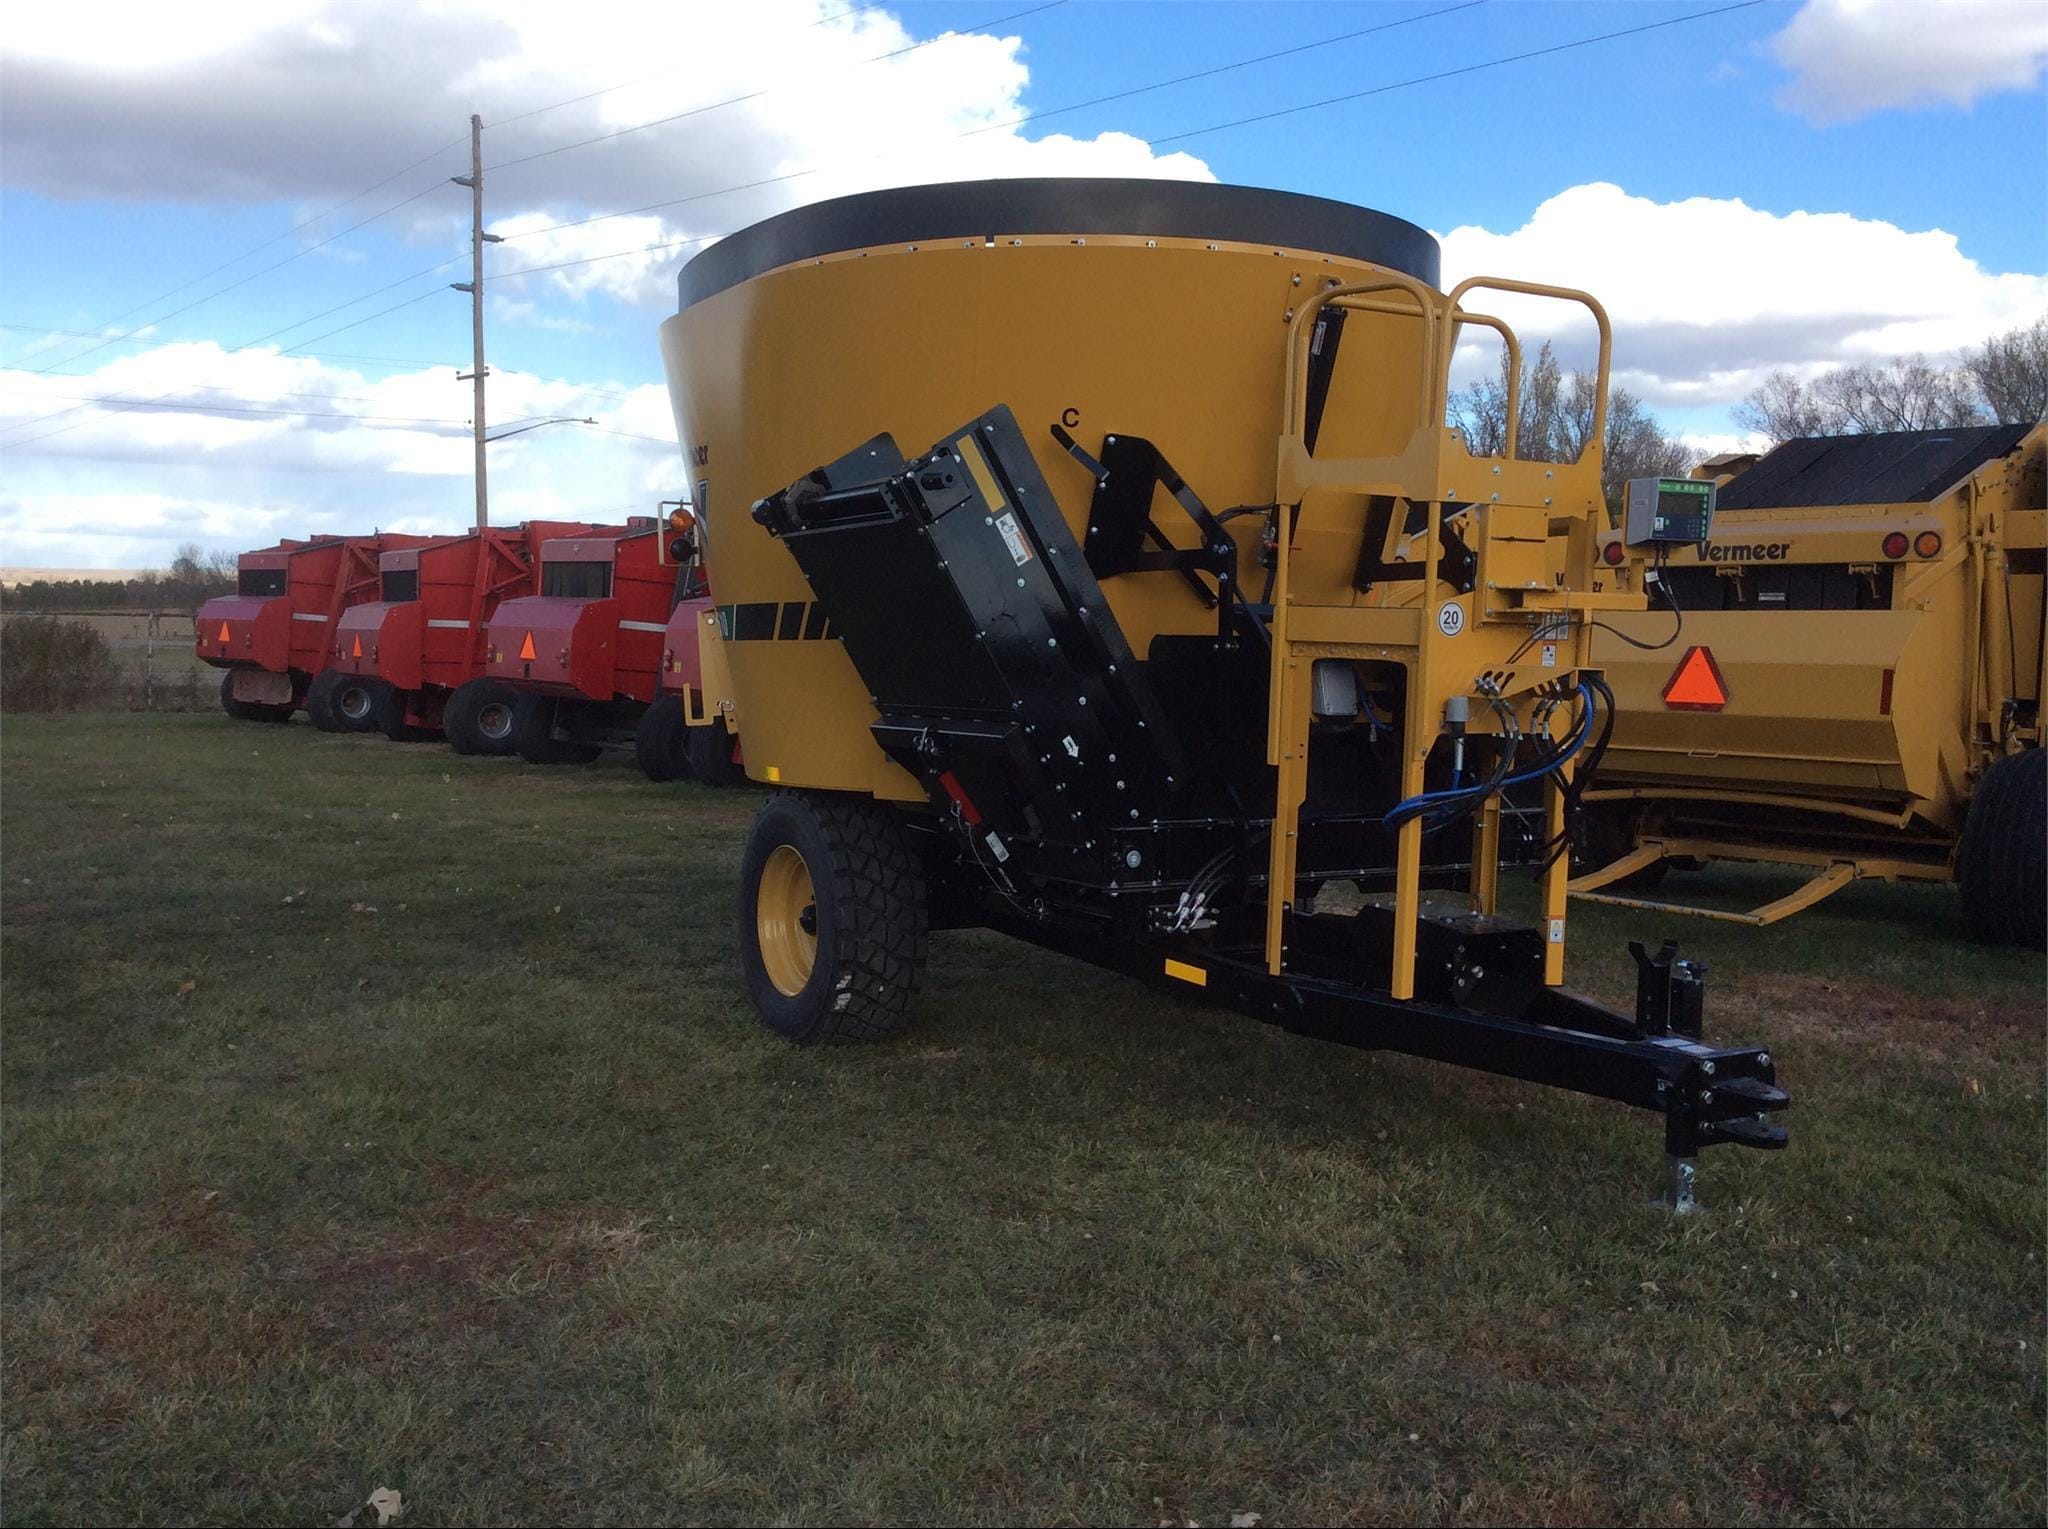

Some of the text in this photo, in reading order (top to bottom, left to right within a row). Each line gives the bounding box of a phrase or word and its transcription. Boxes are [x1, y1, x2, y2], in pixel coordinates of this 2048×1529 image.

[1062, 408, 1080, 428] C
[1696, 541, 1790, 562] Vermeer
[1443, 610, 1459, 625] 20
